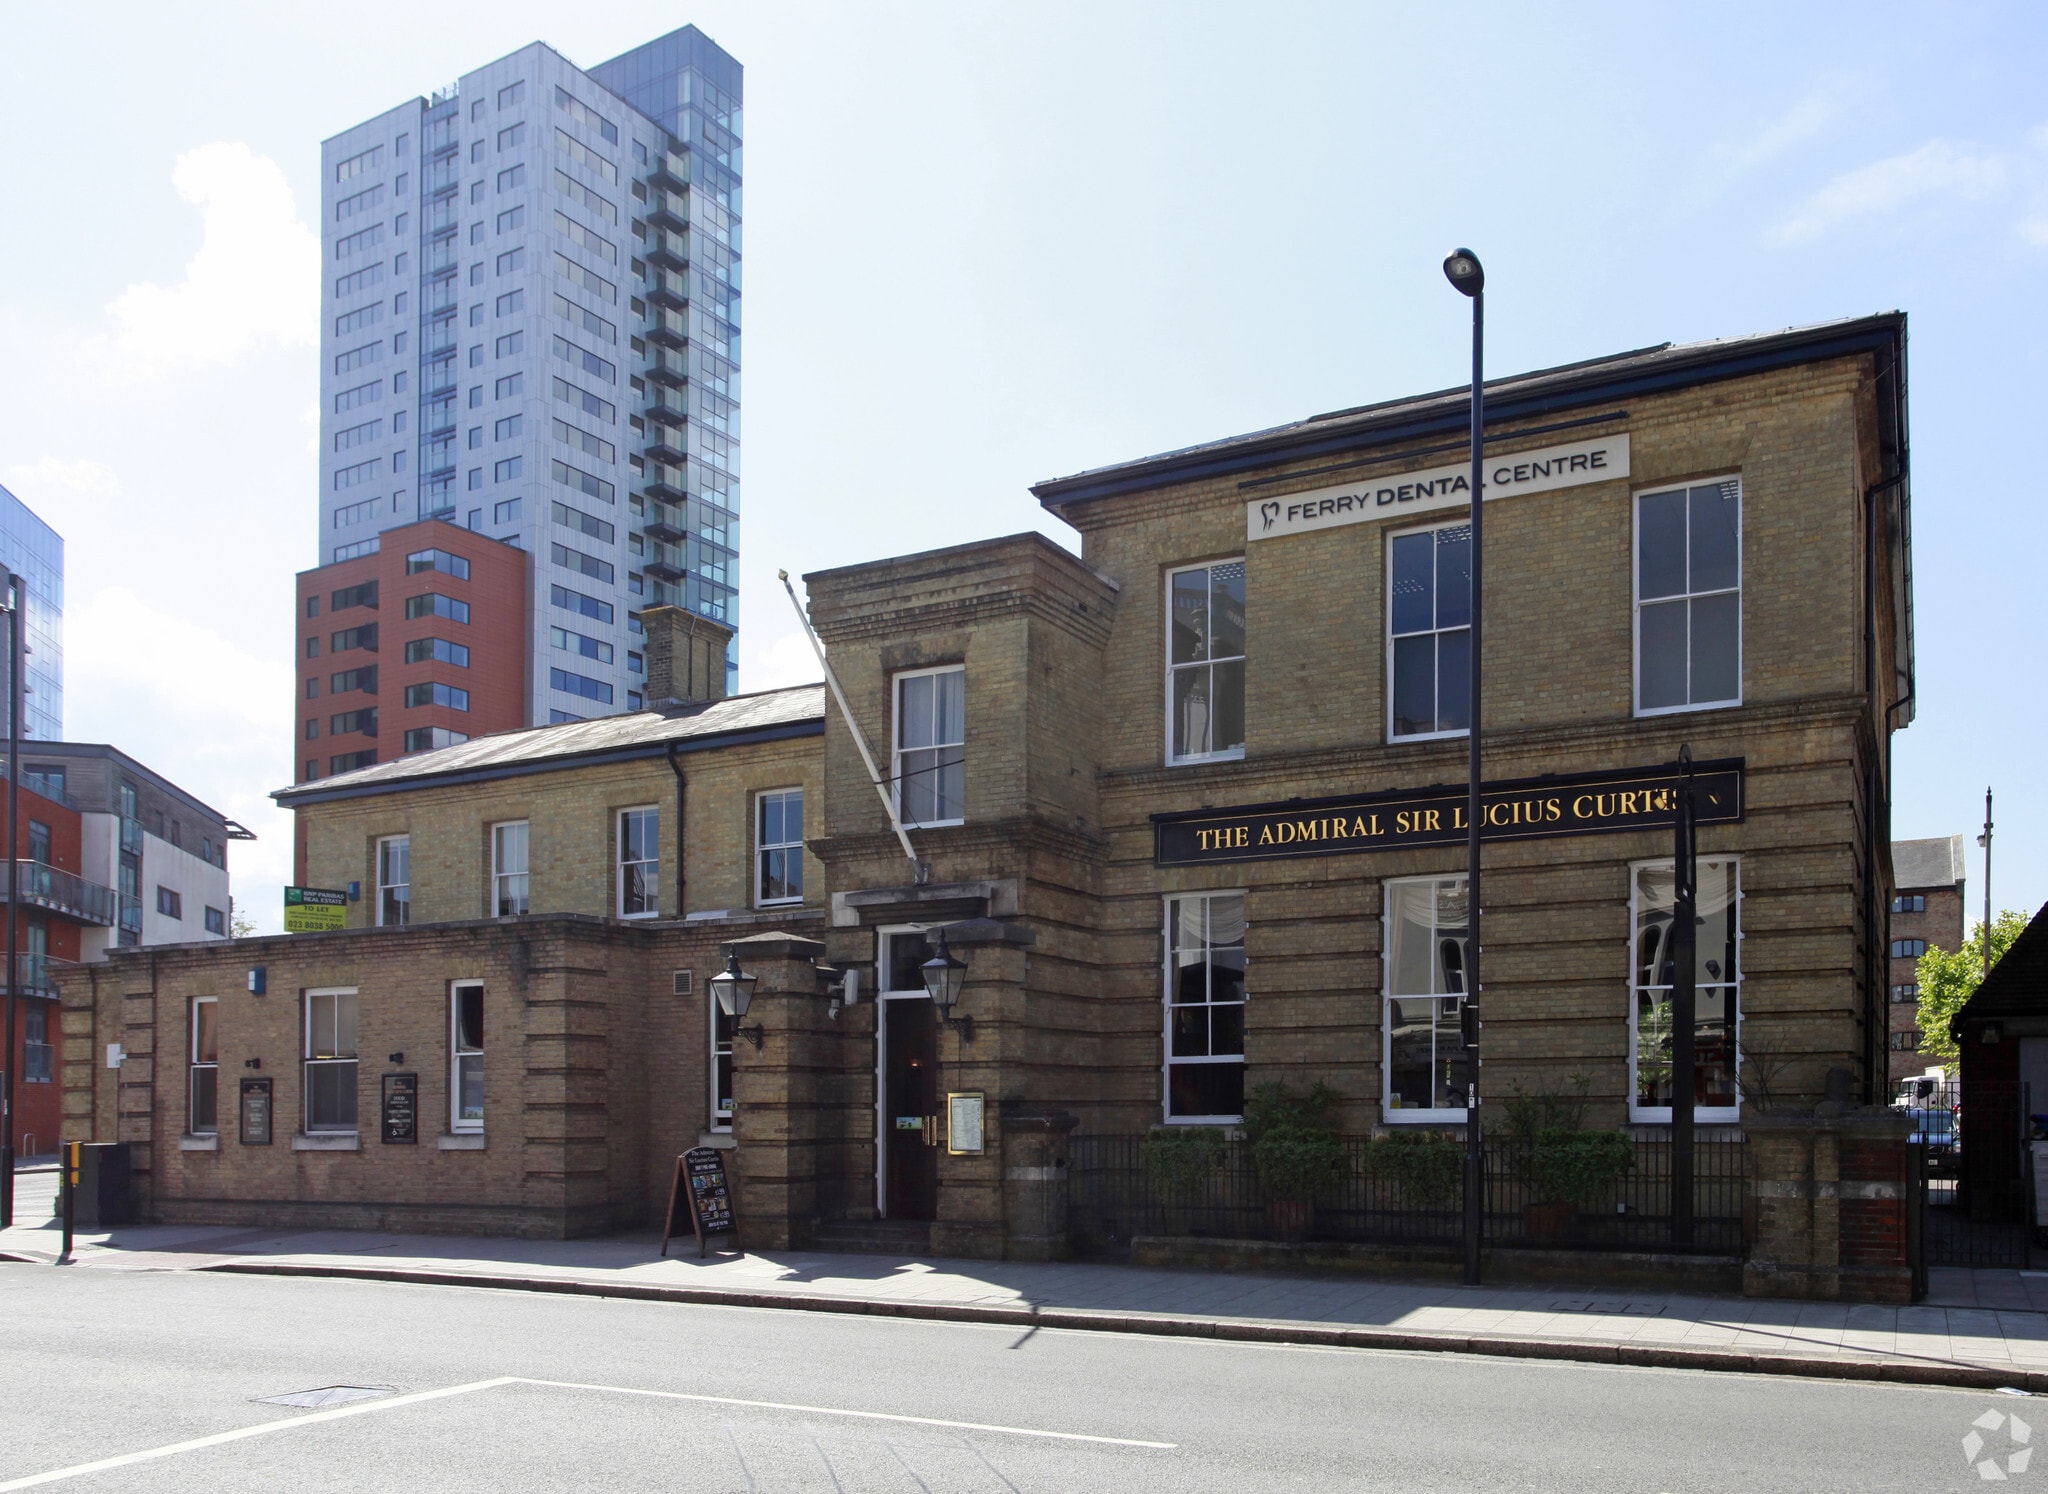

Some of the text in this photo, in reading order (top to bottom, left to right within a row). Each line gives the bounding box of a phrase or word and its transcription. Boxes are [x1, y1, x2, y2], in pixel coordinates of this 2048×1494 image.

[1287, 450, 1607, 521] FERRY DENTA CENTRE
[1196, 827, 1249, 851] THE
[1258, 814, 1384, 844] ADMIRAL
[1395, 809, 1442, 834] SIR
[1573, 788, 1677, 818] CURTI
[288, 920, 303, 928] 023
